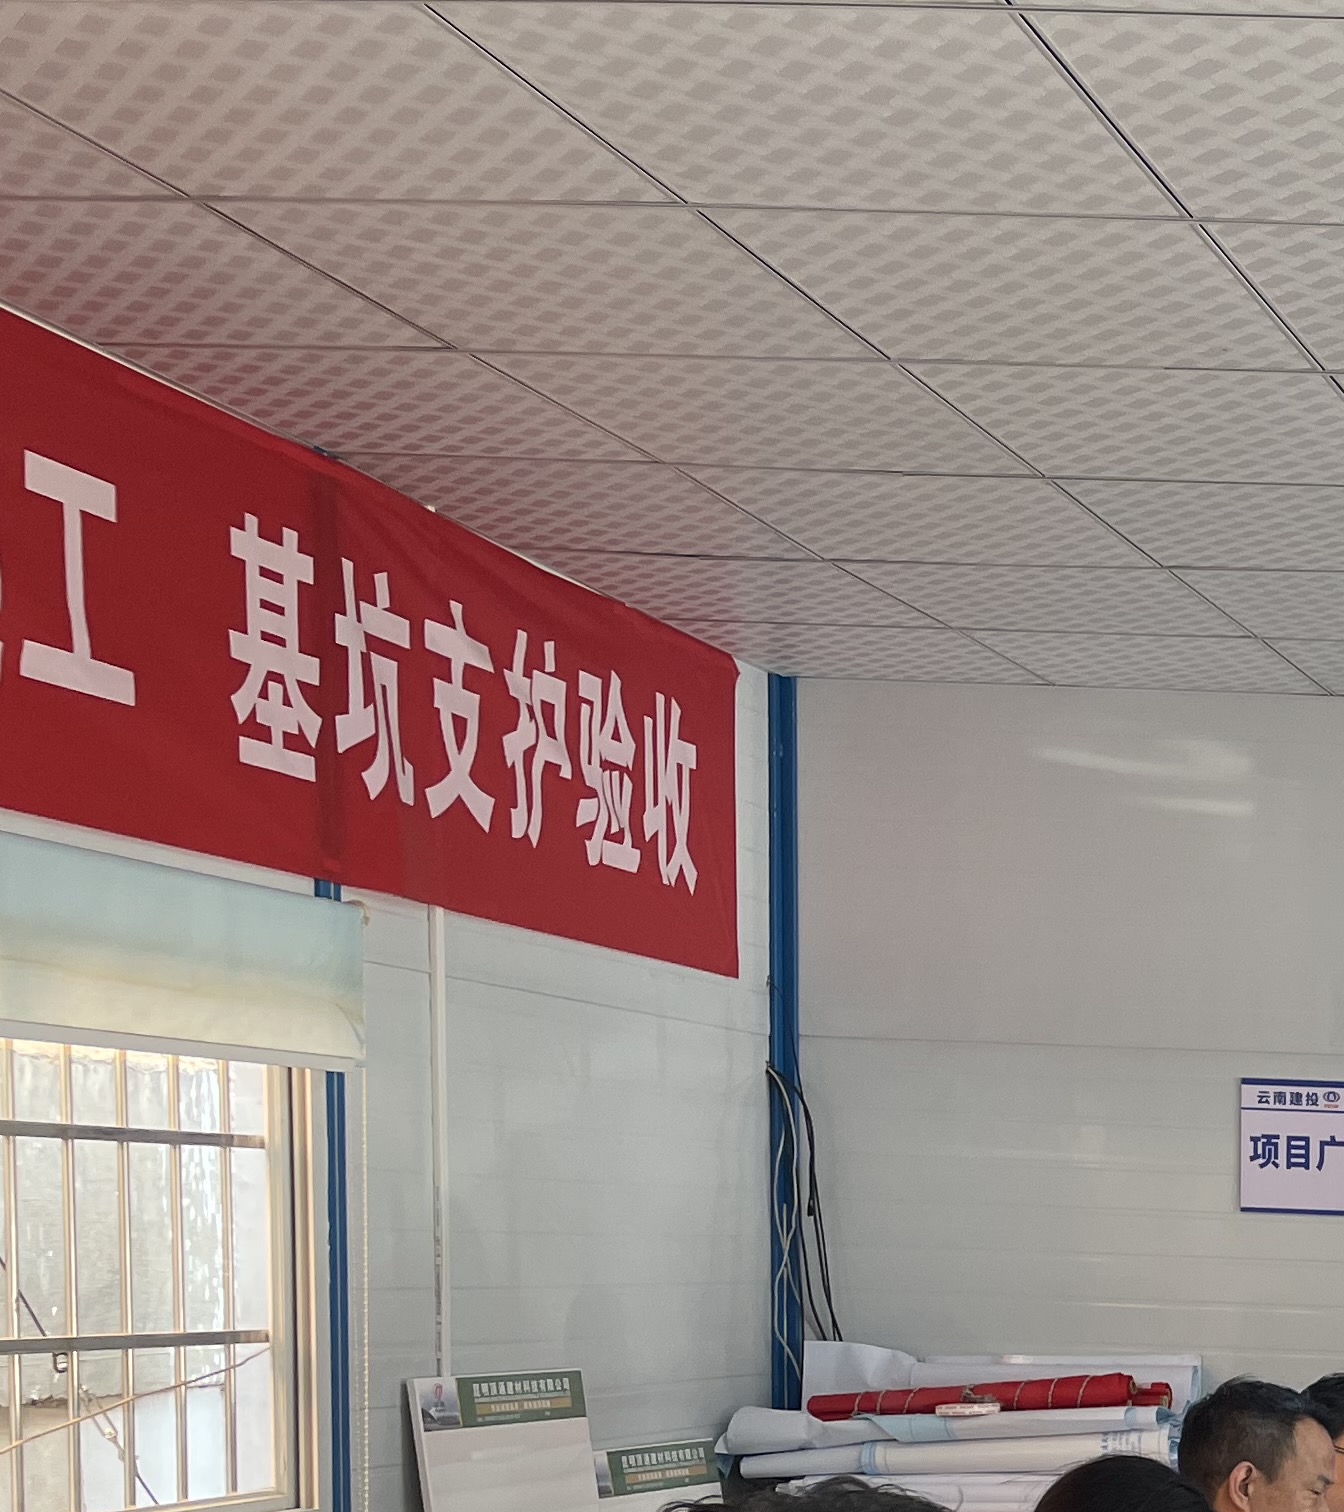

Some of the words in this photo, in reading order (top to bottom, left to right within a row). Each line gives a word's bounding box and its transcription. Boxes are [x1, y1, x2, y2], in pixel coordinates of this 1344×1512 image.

[0, 450, 135, 706] 工
[228, 512, 697, 895] 基坑支护验收
[1257, 1091, 1319, 1106] 云南建投
